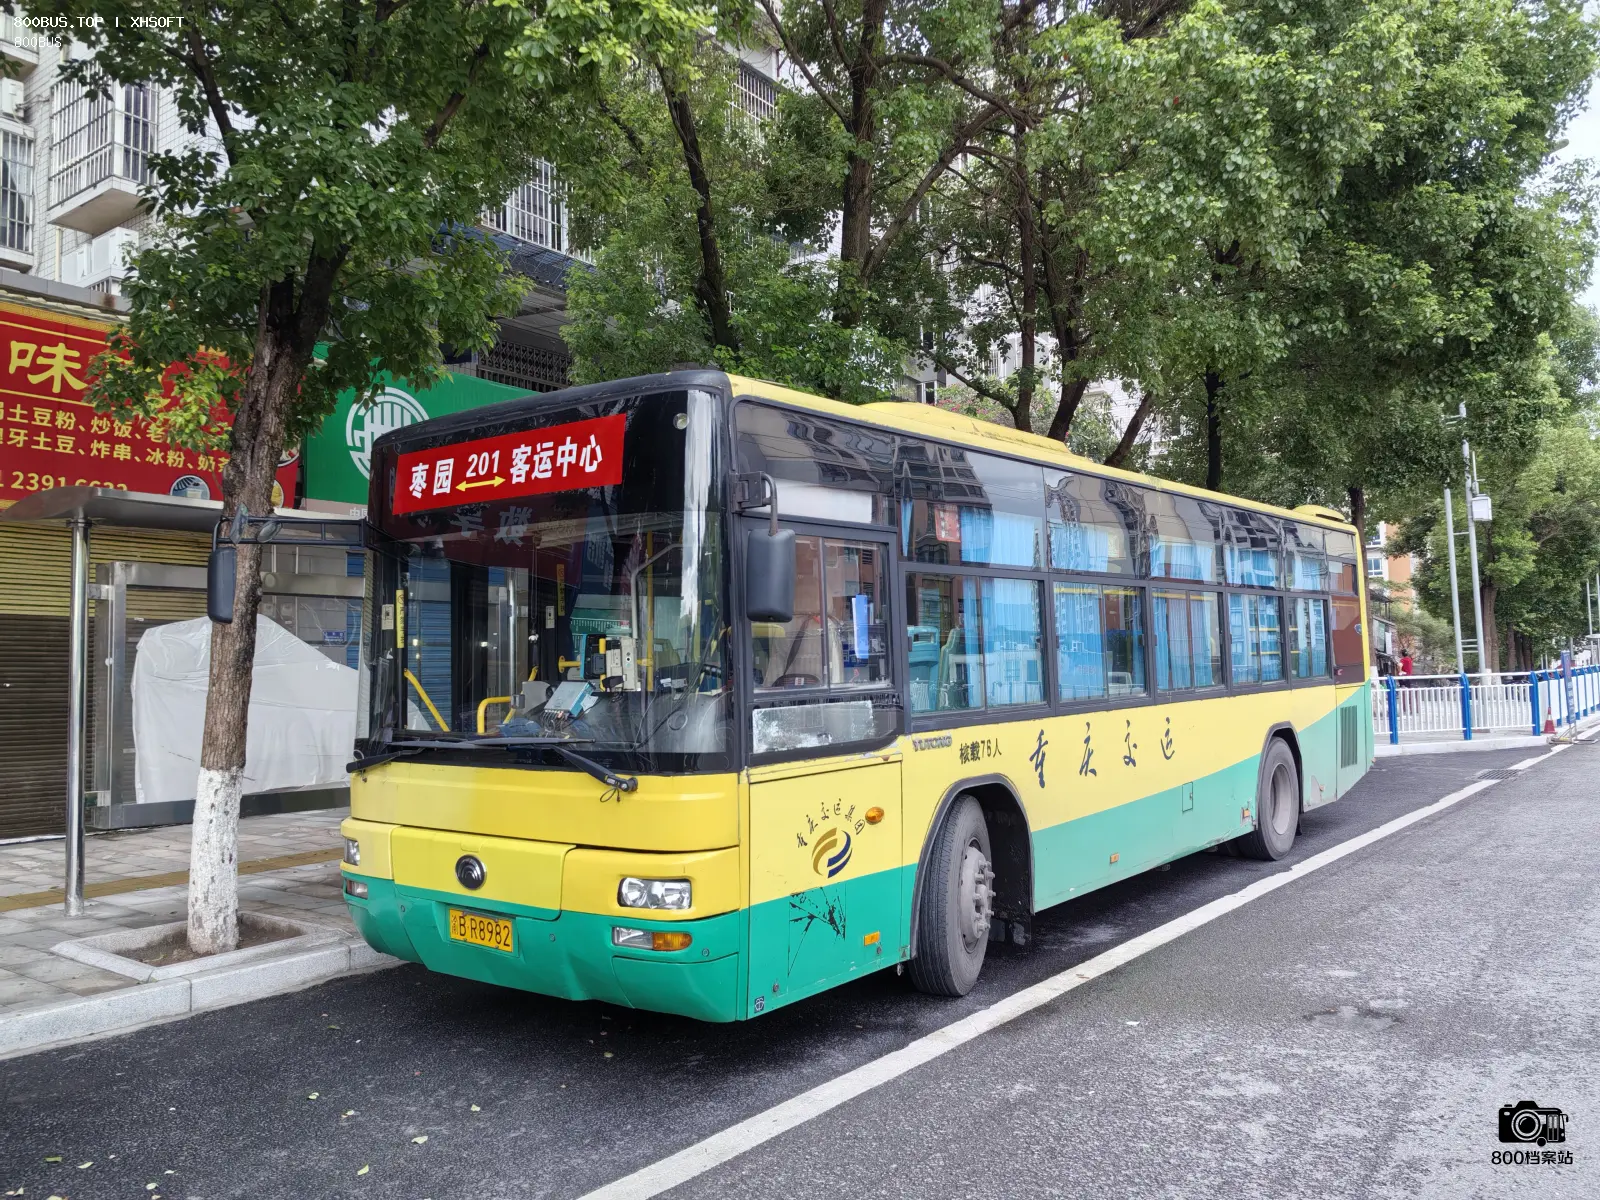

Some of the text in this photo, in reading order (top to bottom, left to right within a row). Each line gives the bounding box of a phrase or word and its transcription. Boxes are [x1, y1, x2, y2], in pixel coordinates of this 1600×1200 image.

[8, 340, 89, 393] 味
[0, 401, 166, 444] 土豆粉、炒饭、老
[408, 433, 603, 499] 枣园 201 客运中心
[1029, 716, 1176, 789] 重庆交运
